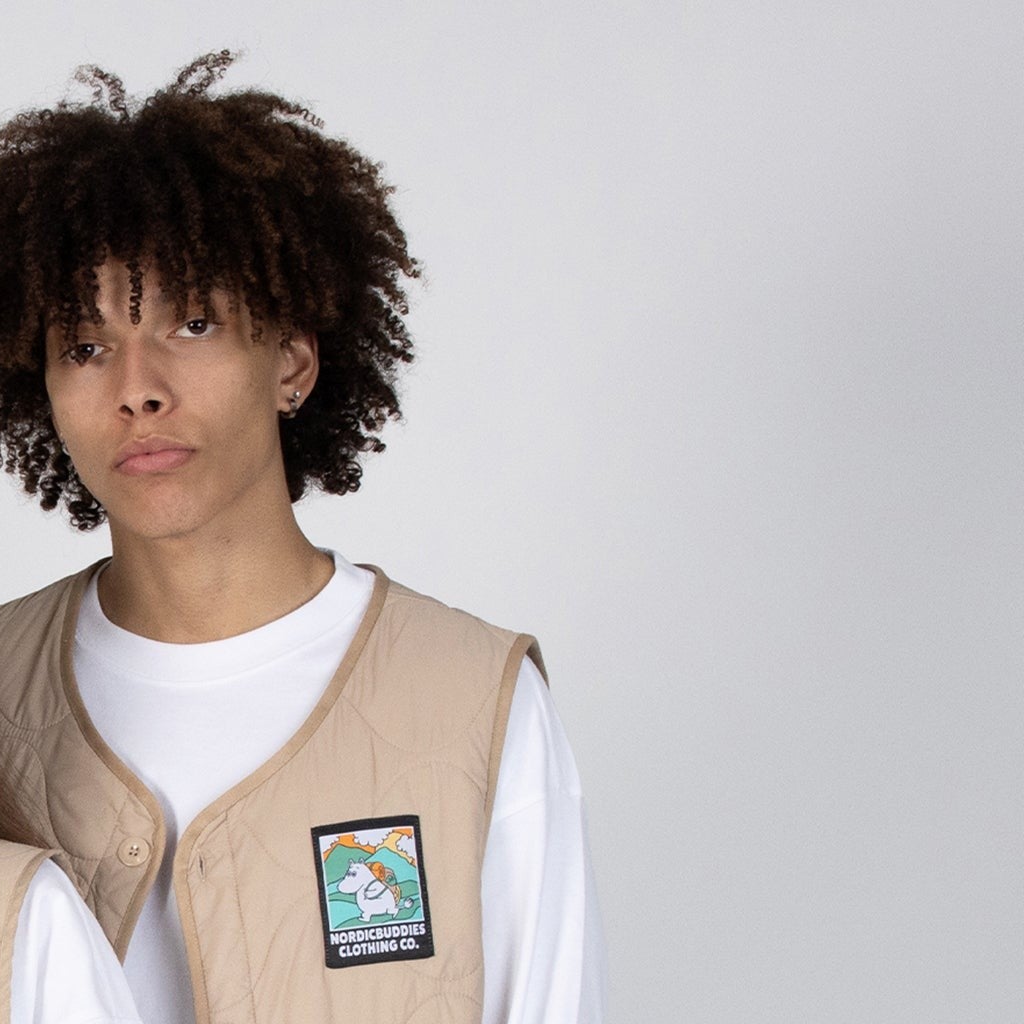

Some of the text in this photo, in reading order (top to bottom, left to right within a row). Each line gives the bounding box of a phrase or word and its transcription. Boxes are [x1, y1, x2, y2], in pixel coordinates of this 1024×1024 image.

[330, 923, 426, 945] NORDICBUDDIES
[339, 938, 420, 957] CLOTHING CO.
